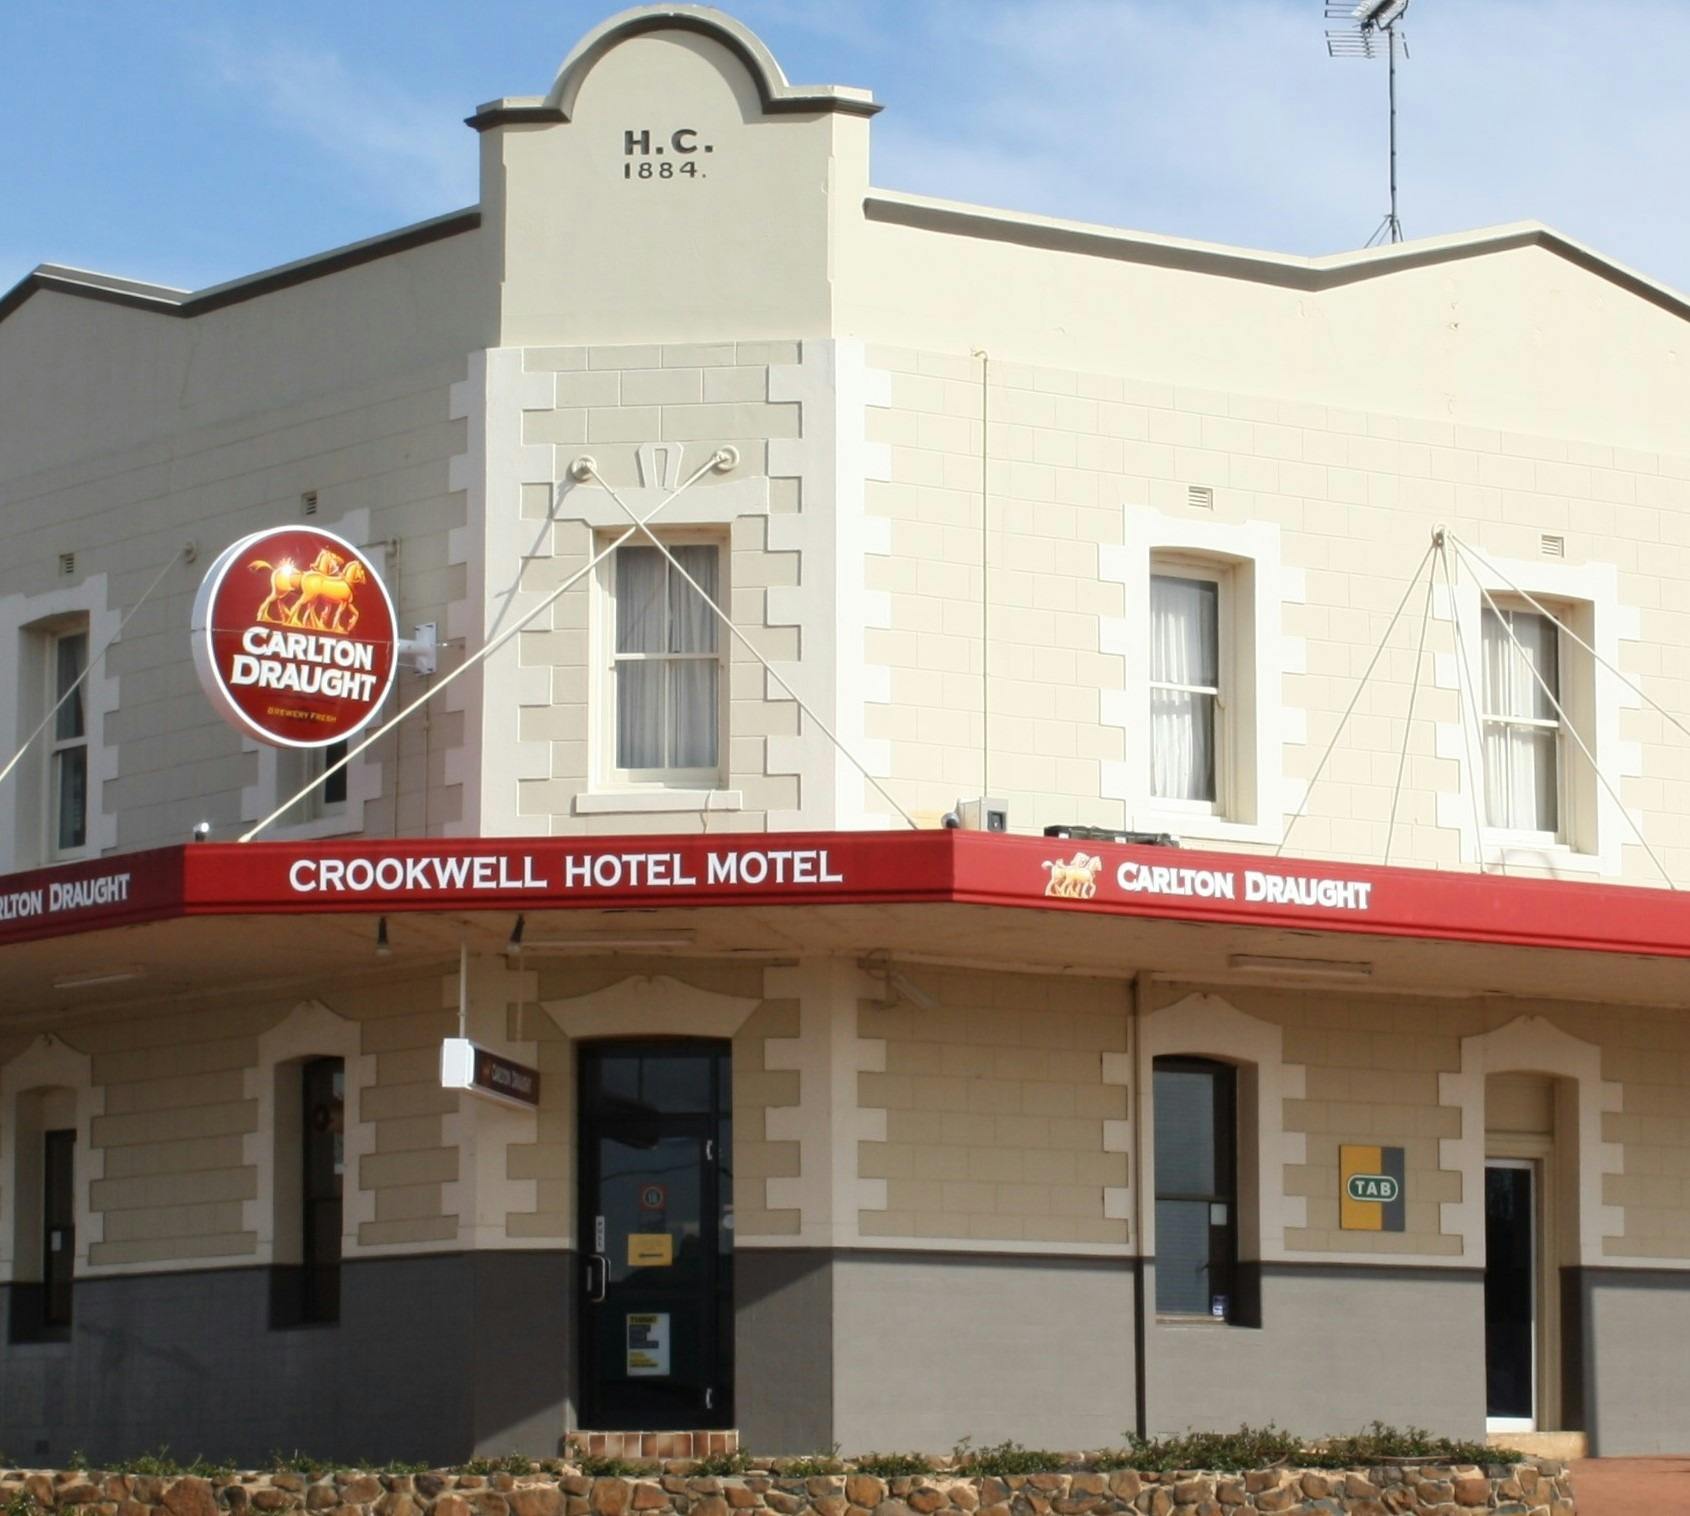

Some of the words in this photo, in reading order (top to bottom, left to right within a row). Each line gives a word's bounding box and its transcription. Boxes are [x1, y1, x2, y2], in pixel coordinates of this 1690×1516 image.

[624, 128, 713, 155] H.C.
[624, 161, 706, 179] 1884.
[242, 626, 375, 671] CARLTON
[230, 654, 377, 702] DRAUGHT
[289, 855, 548, 892] CROOKWELL
[565, 853, 697, 888] HOTEL
[707, 850, 843, 885] MOTEL
[1116, 862, 1235, 900] CARLTON
[1244, 870, 1372, 910] DRAUGHT
[50, 873, 131, 913] DRAUGHT
[1355, 1180, 1392, 1197] TAB
